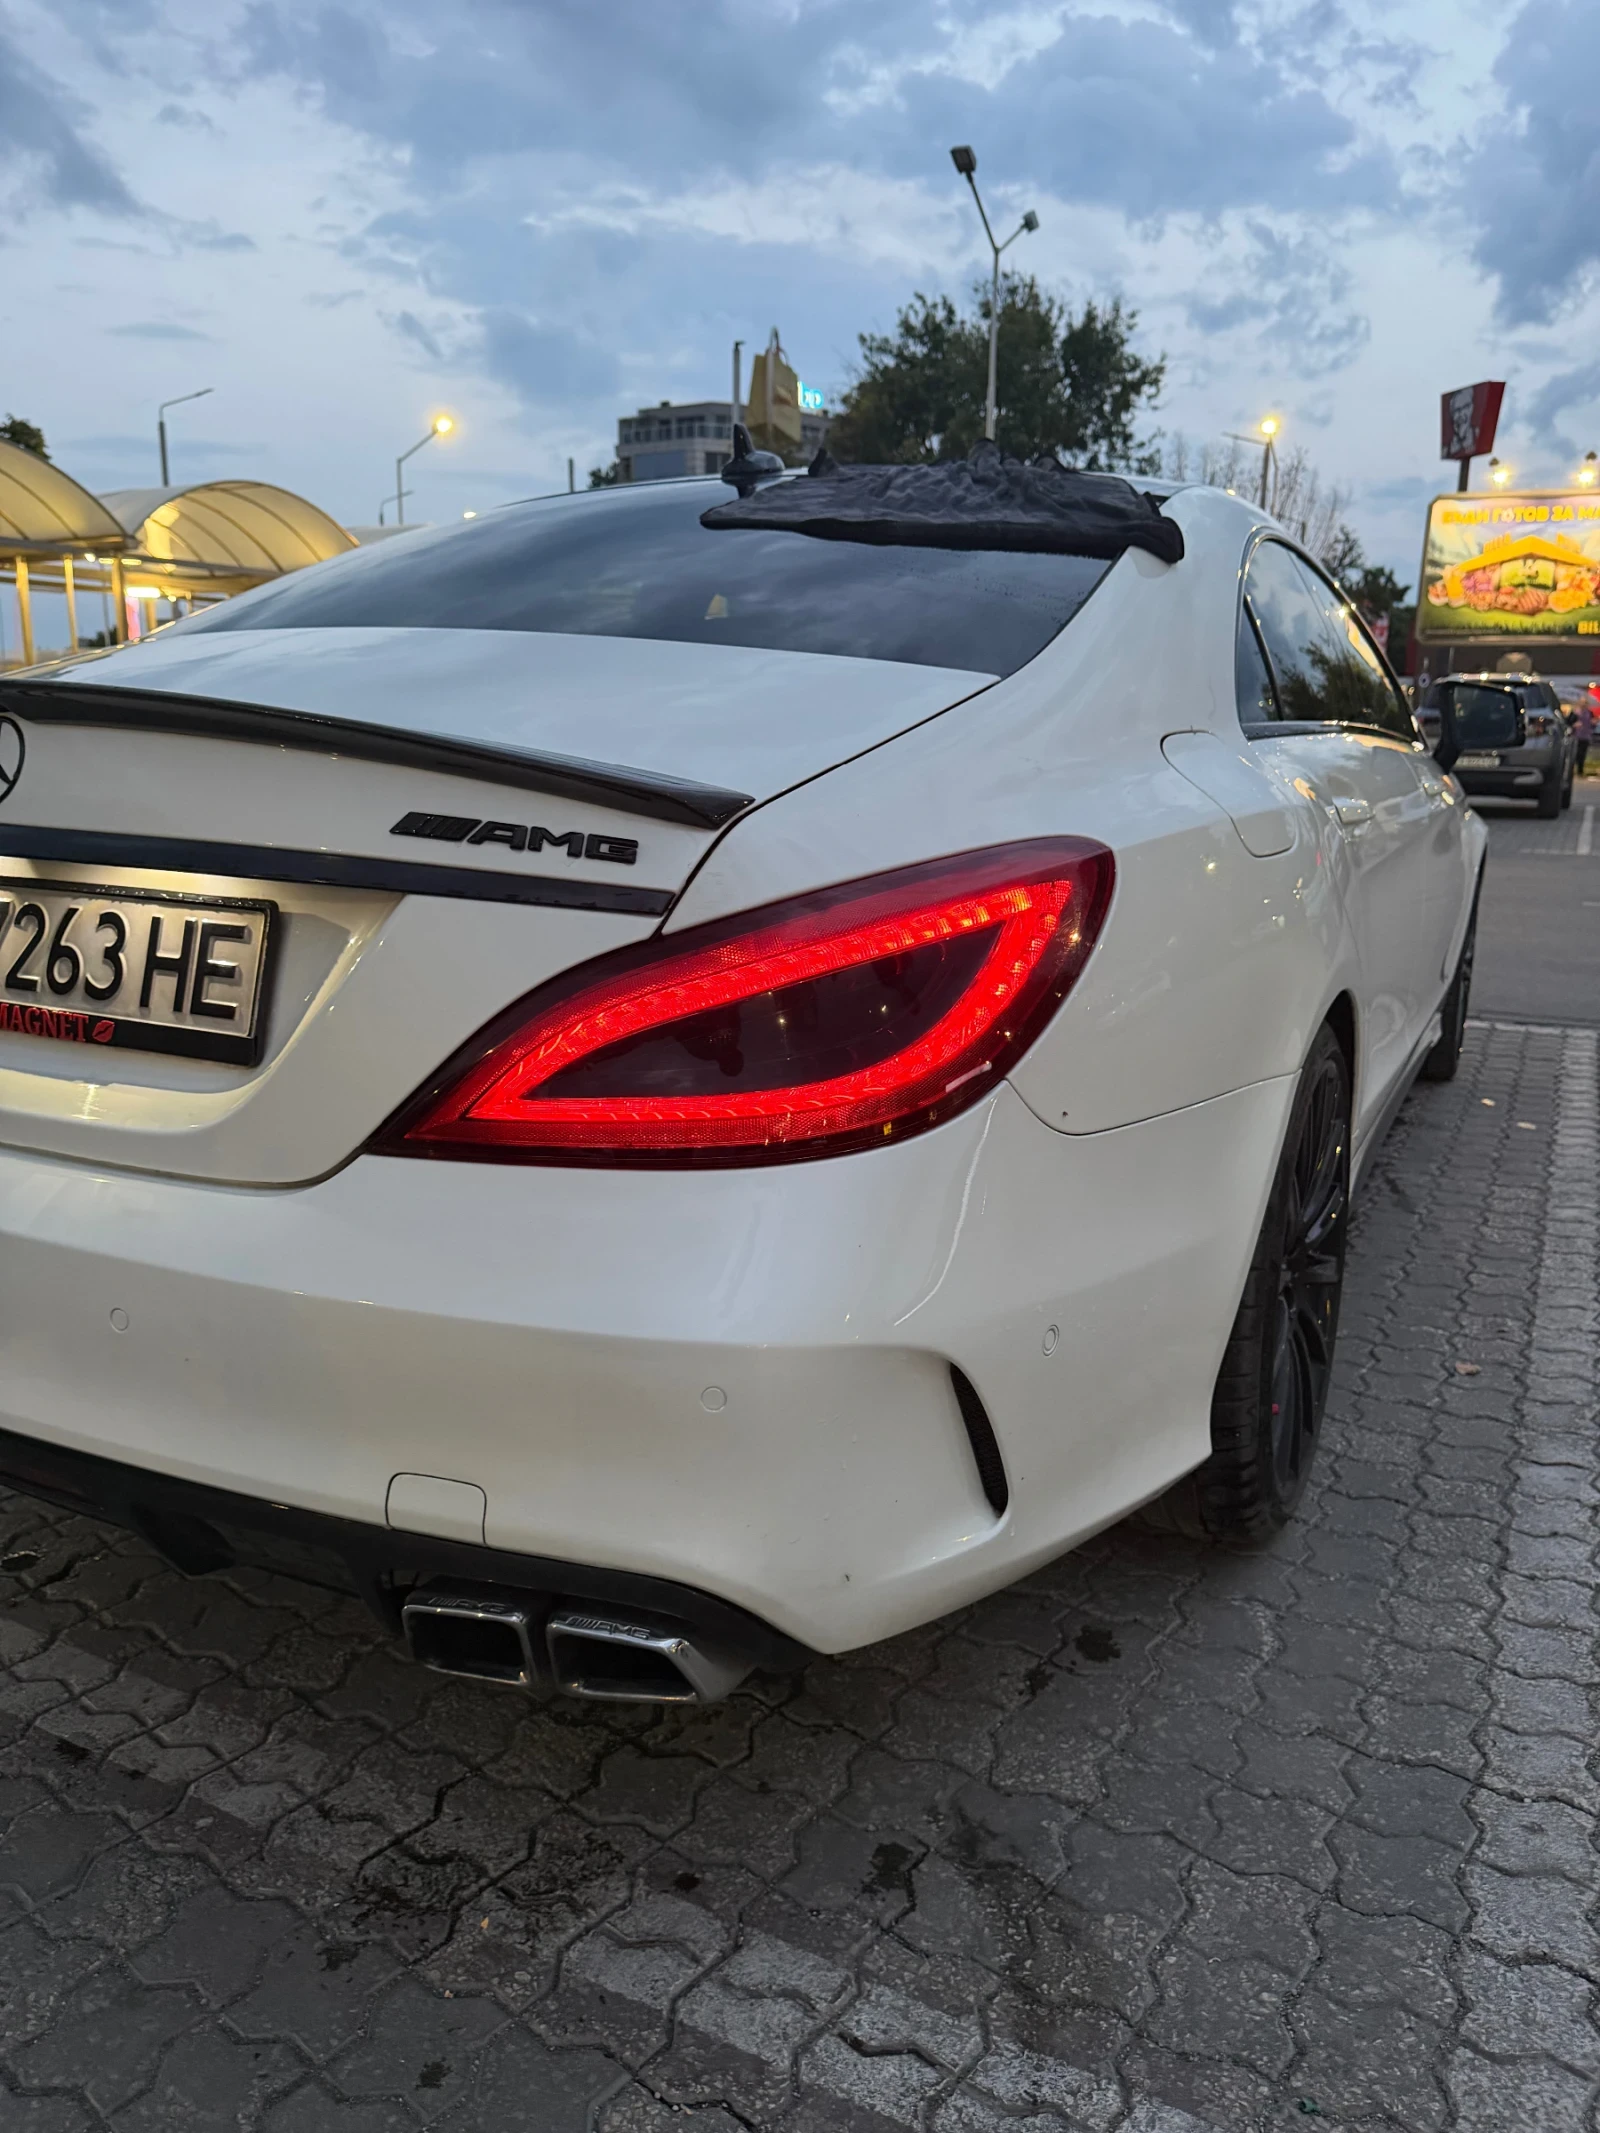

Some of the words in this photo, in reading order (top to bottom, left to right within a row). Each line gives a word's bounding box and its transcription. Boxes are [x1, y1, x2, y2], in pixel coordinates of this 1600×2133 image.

[1492, 505, 1549, 523] ГОТОВ
[1551, 505, 1574, 522] ЗА
[467, 820, 639, 865] AMG
[139, 915, 248, 1020] HE
